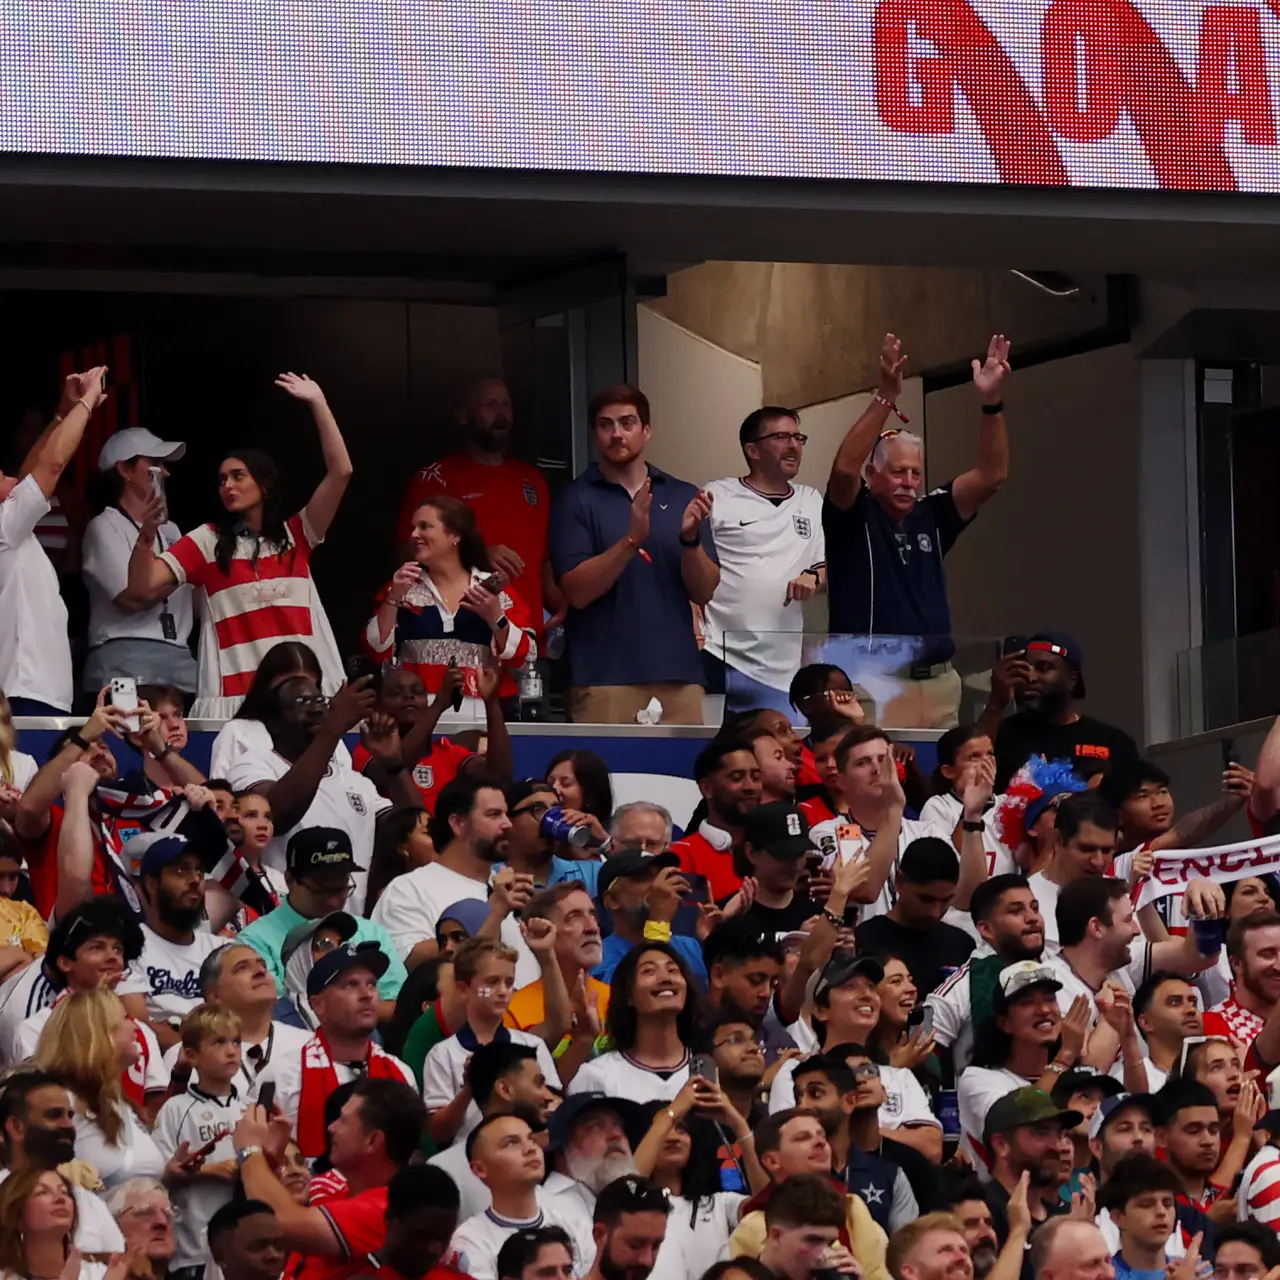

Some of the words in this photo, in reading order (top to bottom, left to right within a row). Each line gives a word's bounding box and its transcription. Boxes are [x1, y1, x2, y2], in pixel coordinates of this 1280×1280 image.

[986, 851, 997, 877] 7
[147, 967, 200, 994] Chels
[199, 1121, 237, 1142] ENGL
